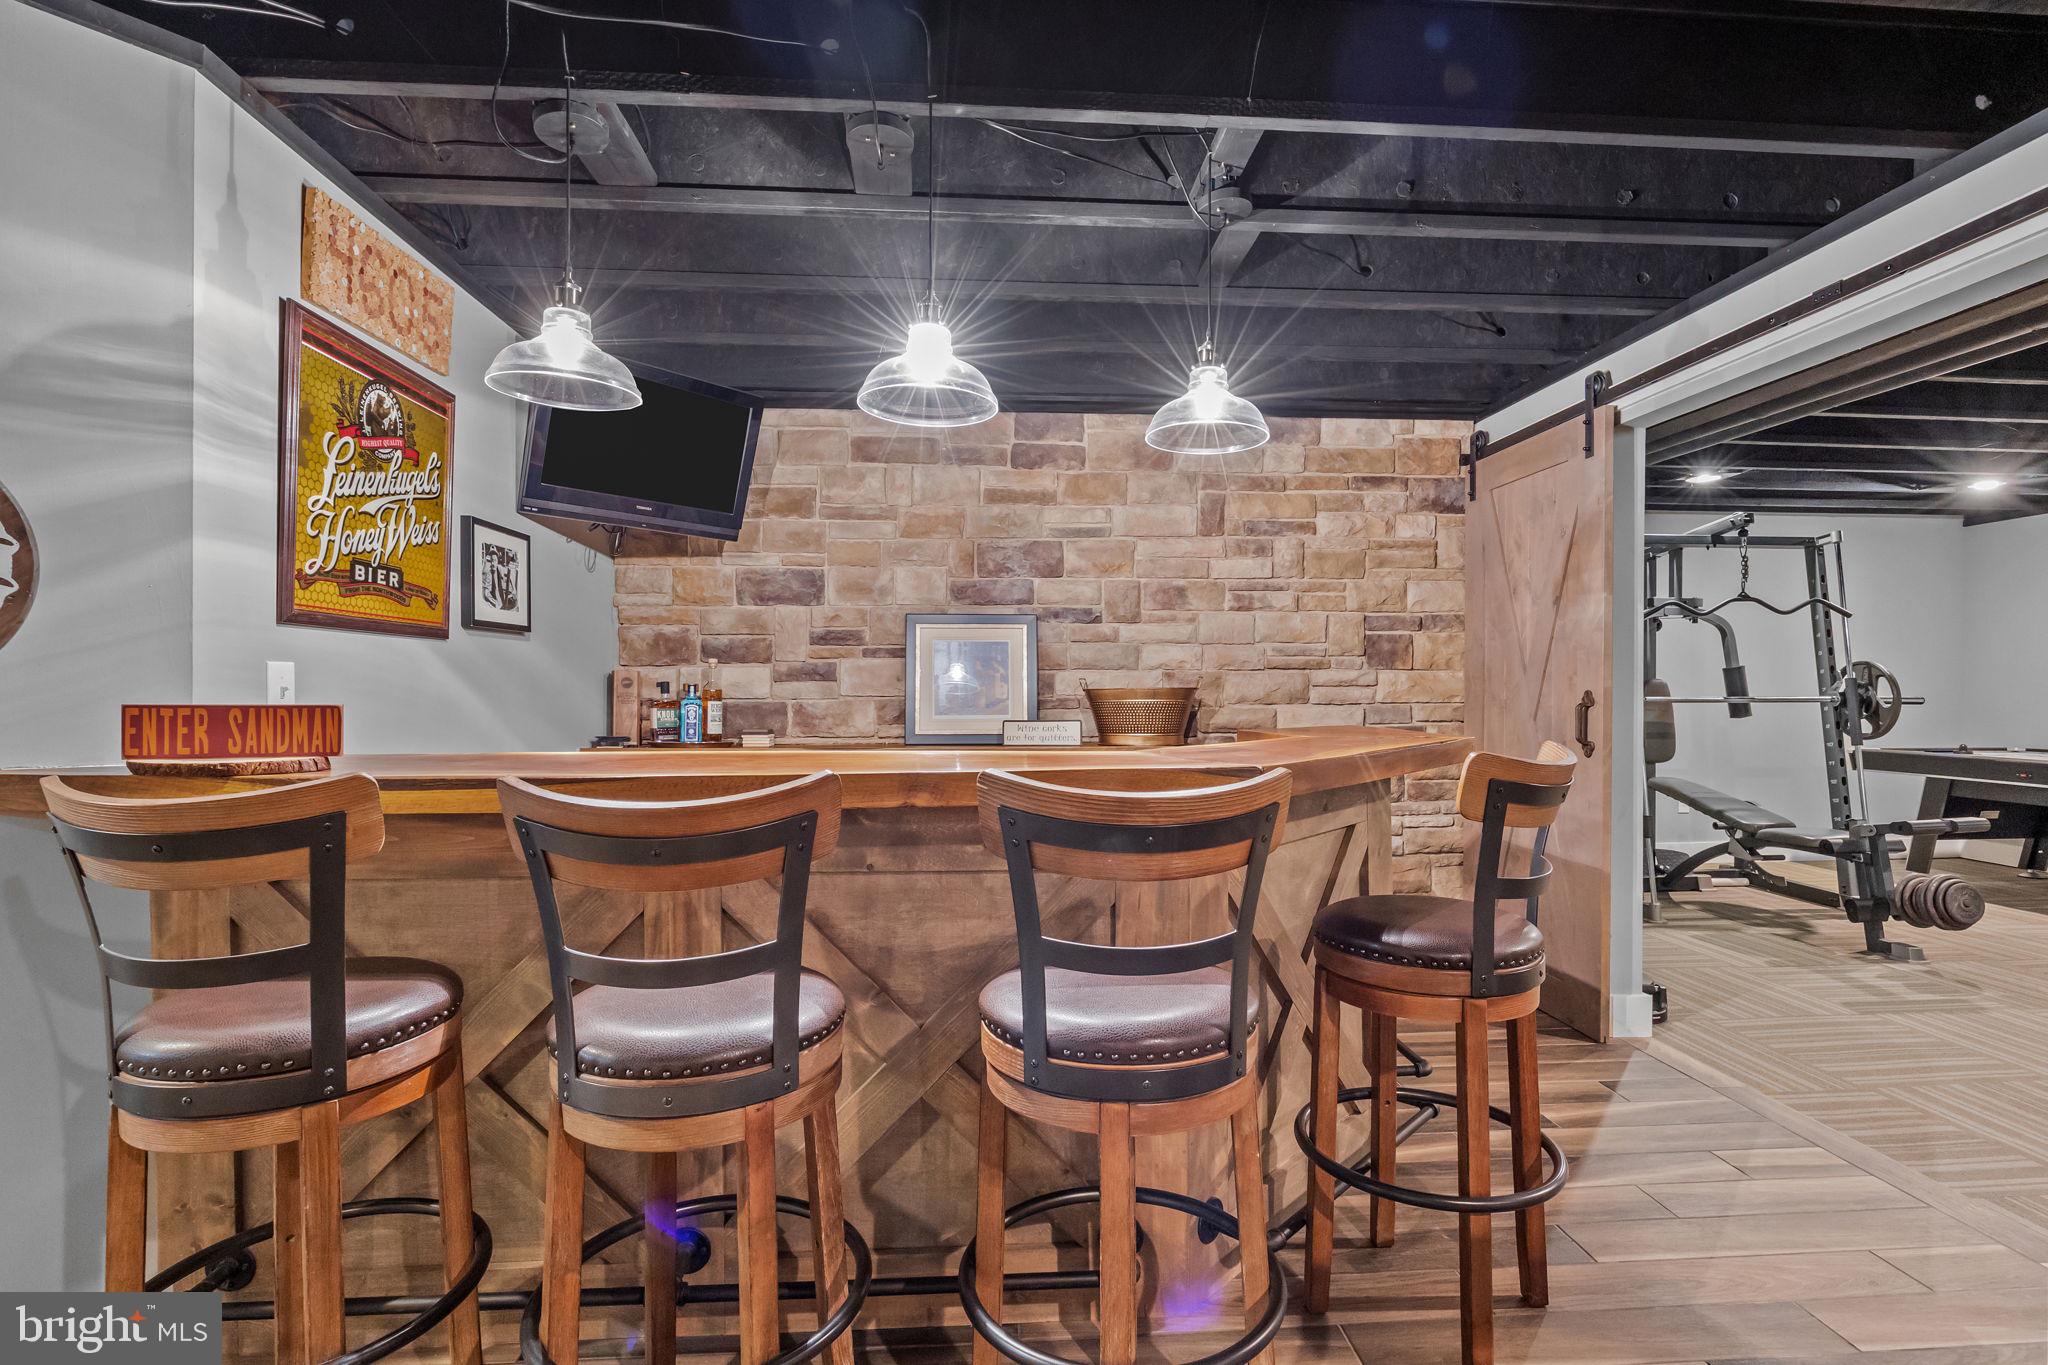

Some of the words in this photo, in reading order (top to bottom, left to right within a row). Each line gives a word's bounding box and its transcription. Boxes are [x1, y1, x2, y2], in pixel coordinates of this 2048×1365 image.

[359, 383, 388, 422] LEINENKUGEL
[361, 439, 382, 447] HIGHEST
[383, 439, 404, 447] QUALITY
[307, 432, 442, 513] Leinenkugel's
[304, 506, 386, 576] Honey
[377, 503, 440, 562] Weiss
[354, 564, 399, 588] BIER
[657, 710, 675, 718] KNOB
[124, 707, 209, 756] ENTER
[228, 707, 339, 755] SANDMAN
[1017, 724, 1040, 732] Wine
[1042, 724, 1068, 732] corks
[1024, 733, 1036, 741] for
